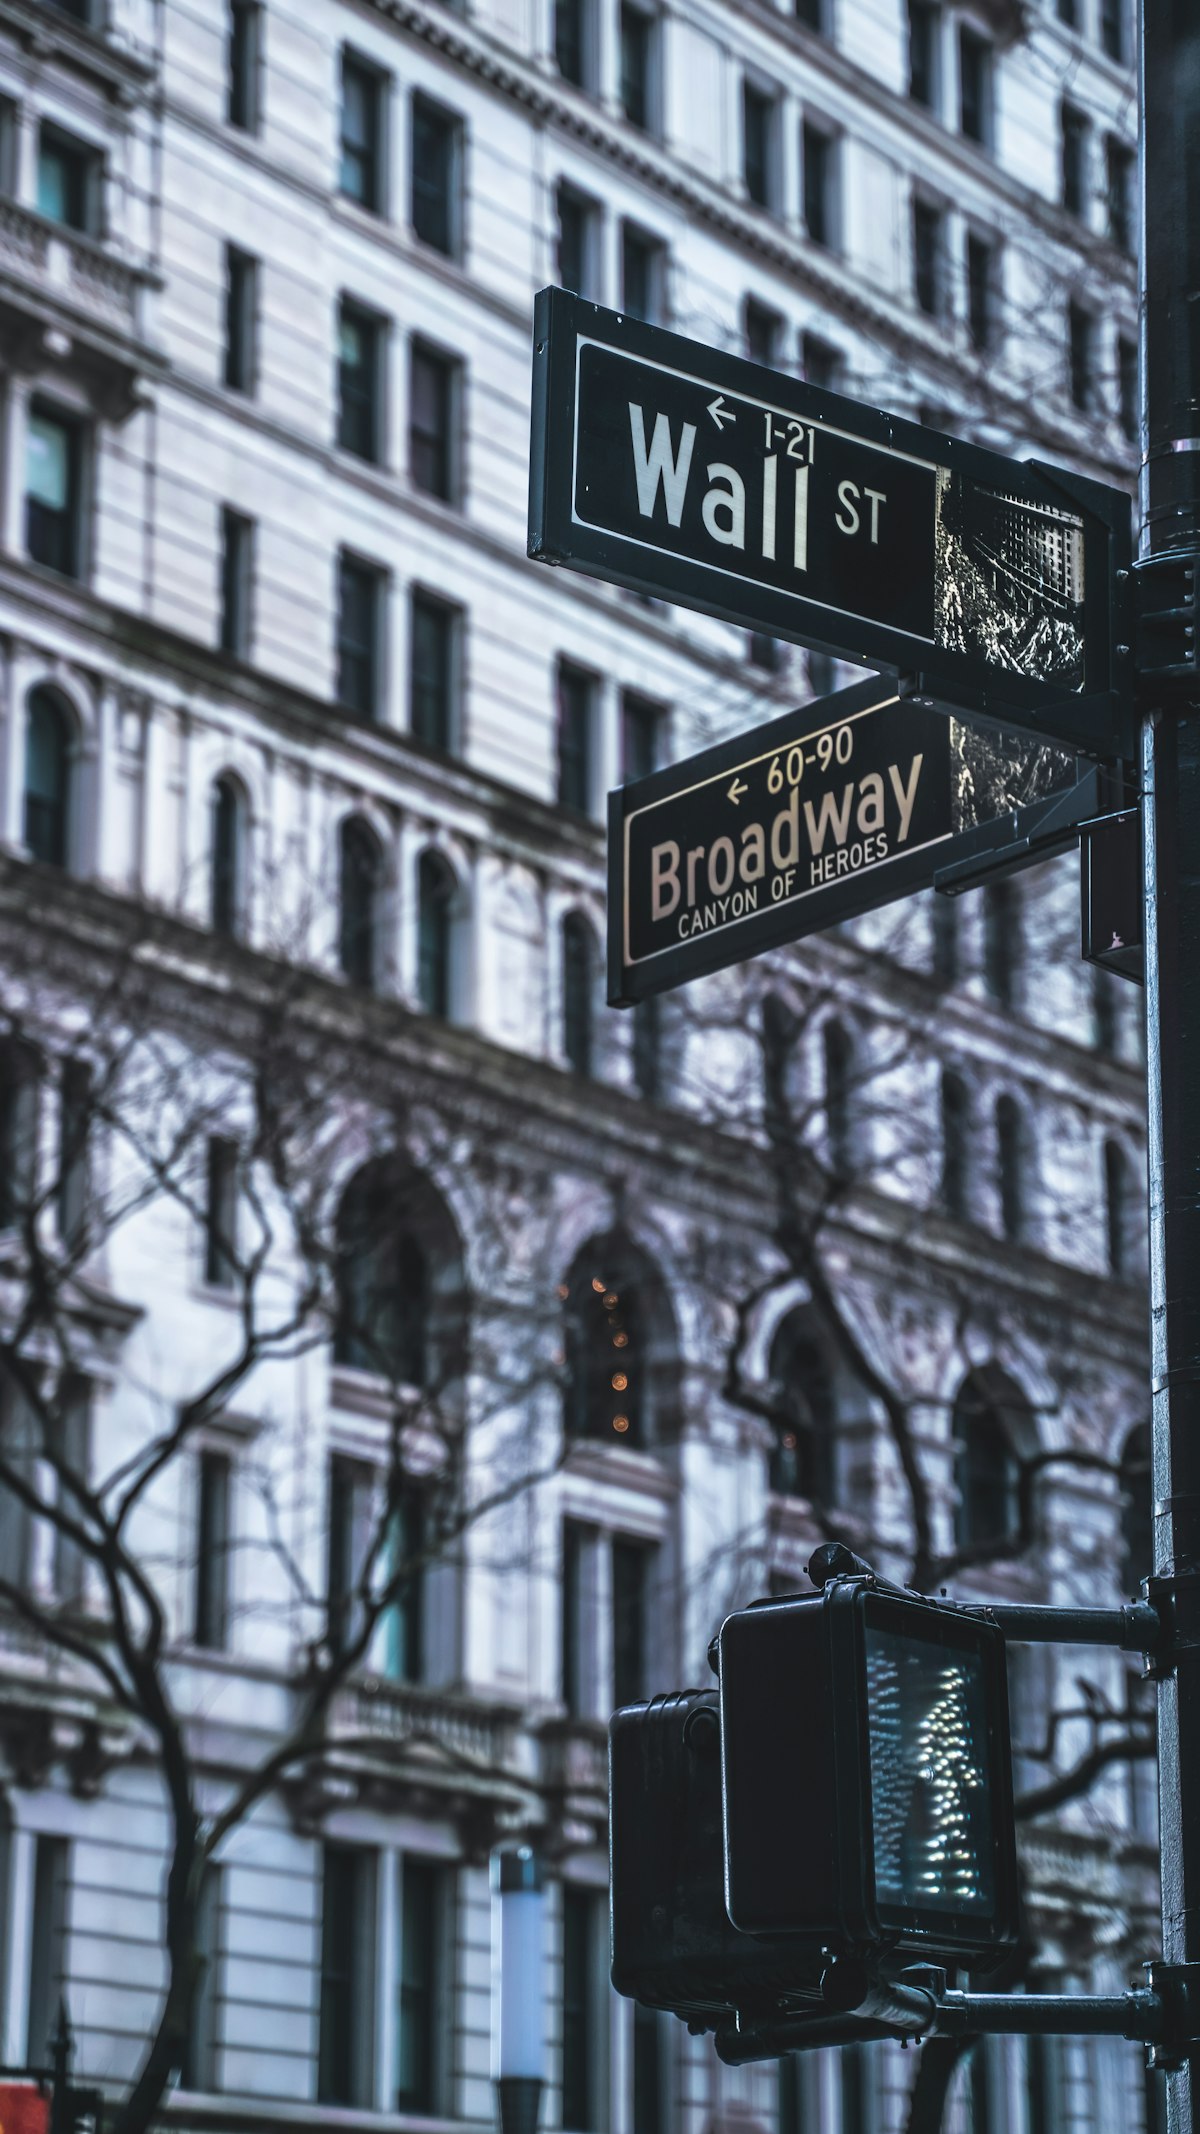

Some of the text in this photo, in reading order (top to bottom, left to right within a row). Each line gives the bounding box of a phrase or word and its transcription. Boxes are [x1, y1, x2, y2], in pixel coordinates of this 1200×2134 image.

[628, 402, 887, 572] Wall ST
[764, 413, 815, 464] 1-21
[767, 725, 853, 795] 60-90
[651, 753, 923, 923] Broadway
[678, 832, 888, 938] CANYON OF HEROES
